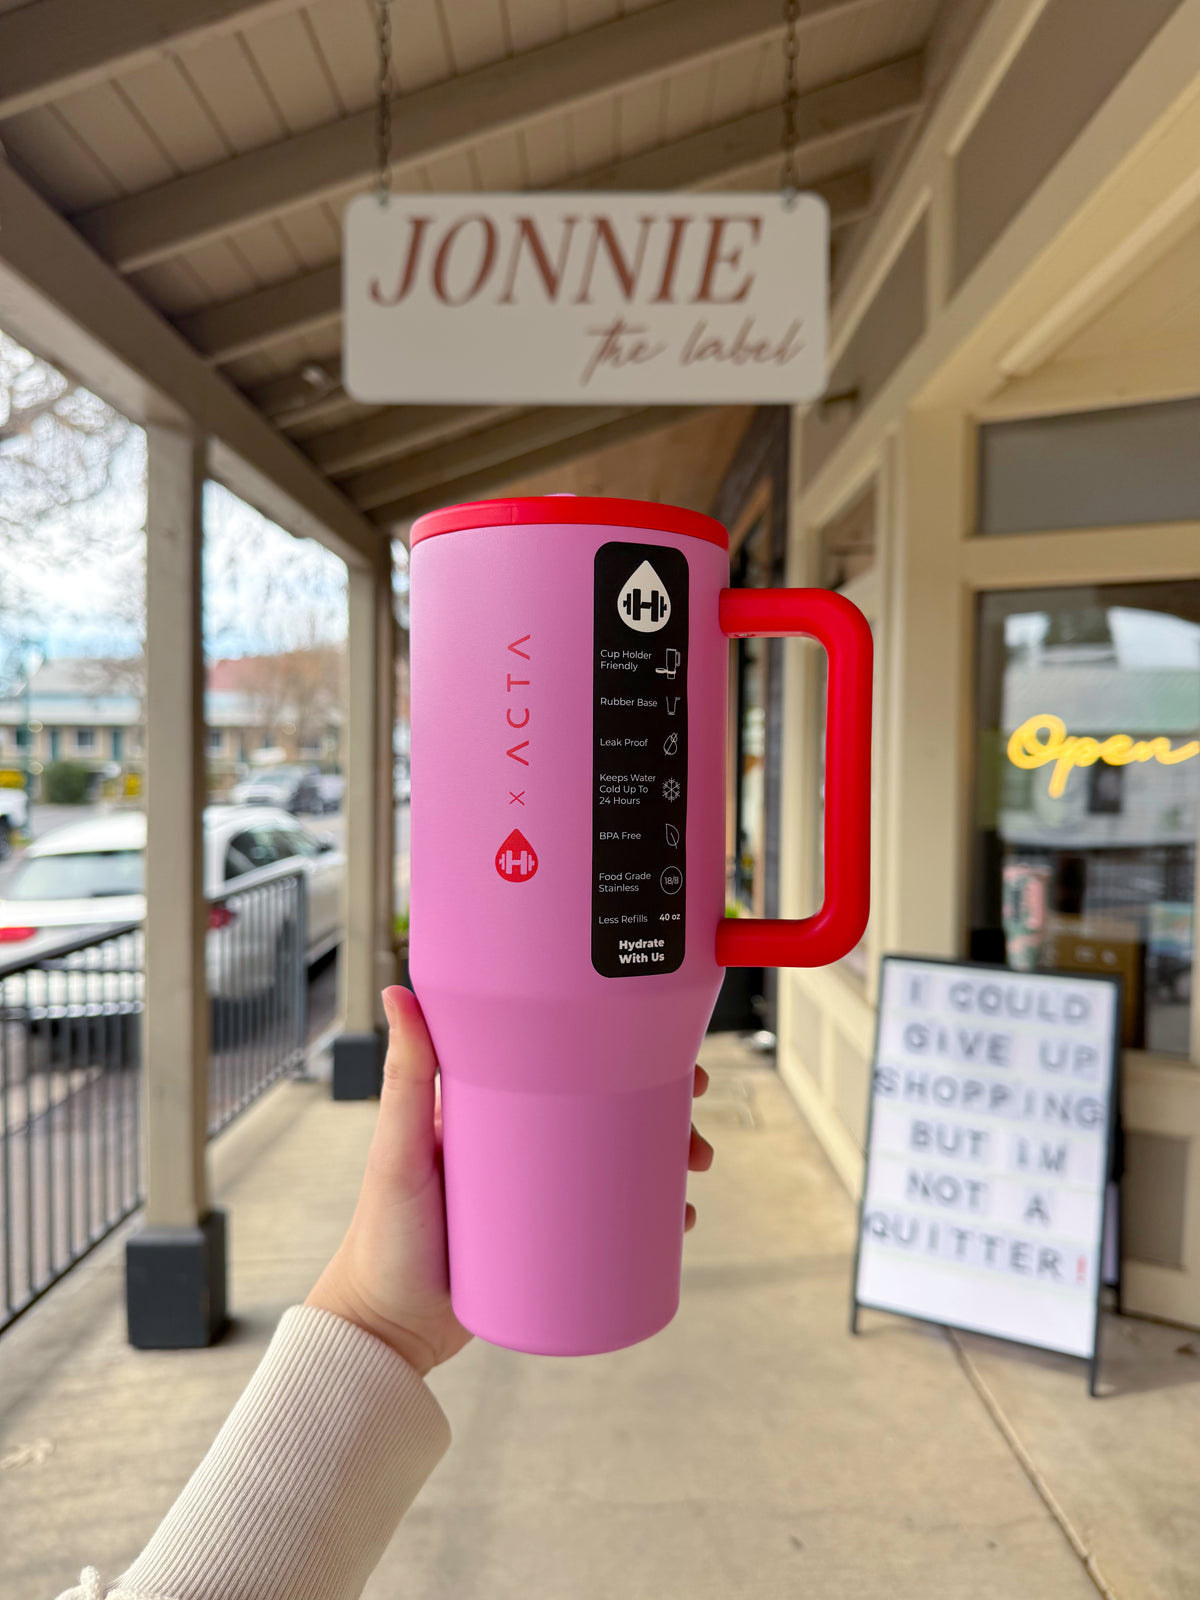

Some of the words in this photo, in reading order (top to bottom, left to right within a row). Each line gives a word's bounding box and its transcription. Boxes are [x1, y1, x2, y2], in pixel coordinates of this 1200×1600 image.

[370, 212, 763, 307] JONNIE
[578, 316, 669, 387] the
[679, 315, 806, 367] label
[600, 649, 620, 660] Cup
[622, 650, 652, 660] Holder
[600, 660, 638, 672] Friendly
[600, 697, 635, 706] Rubber
[637, 698, 658, 707] Base
[600, 738, 622, 747] Leak
[624, 738, 649, 747] Proof
[1007, 713, 1200, 799] Open
[599, 773, 628, 783] Keeps
[630, 774, 656, 782] Water
[599, 785, 621, 794] Cold
[623, 785, 637, 795] Up
[638, 785, 649, 794] To
[599, 797, 611, 806] 24
[613, 796, 641, 806] Hours
[599, 831, 619, 840] BPA
[621, 831, 642, 840] Free
[599, 872, 623, 882] Food
[624, 872, 652, 881] Grade
[664, 876, 679, 886] 18/8
[598, 883, 640, 893] Stainless
[598, 915, 619, 925] Less
[621, 913, 648, 924] Refills
[659, 913, 670, 921] 40
[671, 913, 681, 921] oz
[619, 938, 665, 951] Hydrate
[618, 953, 648, 965] With
[651, 951, 665, 962] Us
[910, 976, 922, 1002] I
[950, 980, 1090, 1024] COULD
[903, 1023, 1012, 1067] GIVE
[1037, 1042, 1098, 1077] UP
[872, 1066, 1105, 1131] SHOPPING
[909, 1119, 988, 1159] BUT
[906, 1170, 985, 1208] NOT
[1023, 1192, 1052, 1227] A
